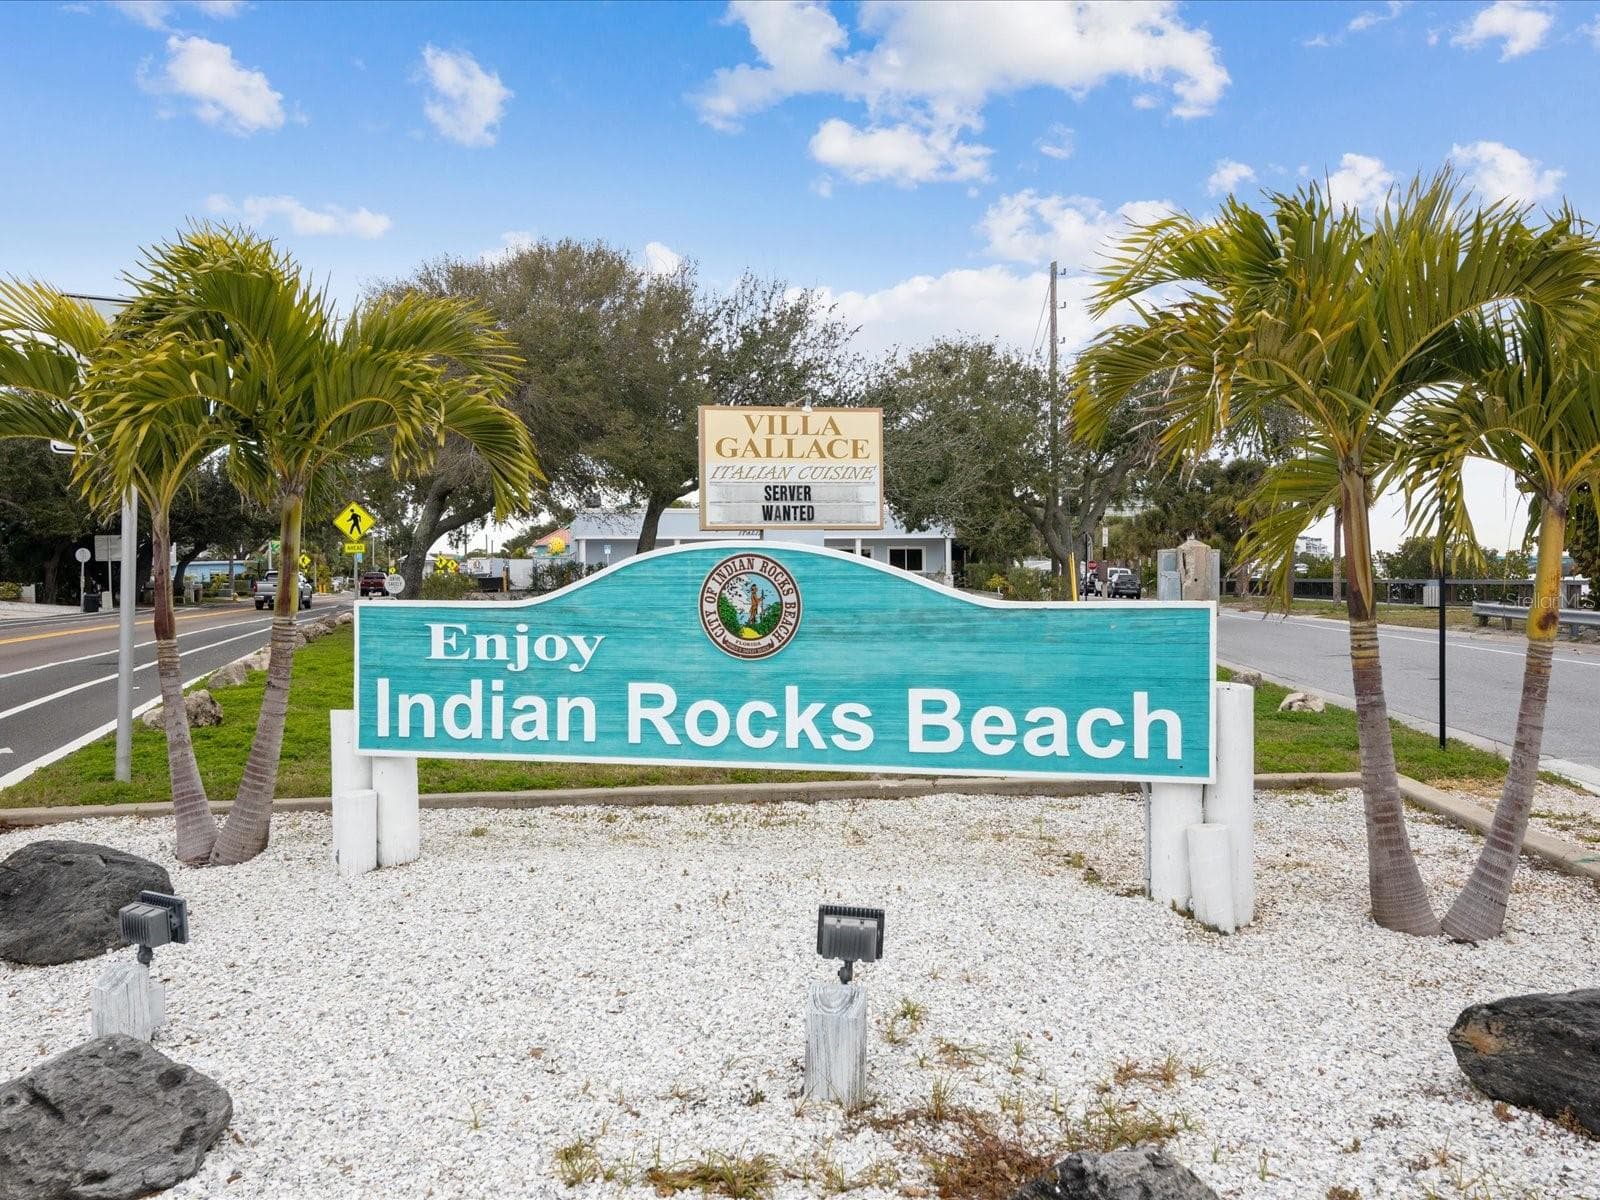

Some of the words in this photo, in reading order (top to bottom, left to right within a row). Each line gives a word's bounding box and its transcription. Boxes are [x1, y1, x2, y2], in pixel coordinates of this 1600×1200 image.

[744, 415, 842, 436] VILLA
[715, 437, 870, 459] GALLACE
[710, 464, 795, 480] ITALIAN
[798, 464, 877, 481] CUISINE
[764, 485, 812, 501] SERVER
[762, 505, 815, 521] WANTED
[712, 558, 755, 586] INDIAN
[760, 560, 794, 597] ROCKS
[704, 587, 718, 604] OF
[705, 610, 725, 638] CITY
[772, 601, 797, 643] BEACH
[425, 623, 606, 673] Enjoy
[377, 678, 597, 743] Indian
[627, 682, 875, 751] Rocks
[908, 688, 1183, 760] Beach
